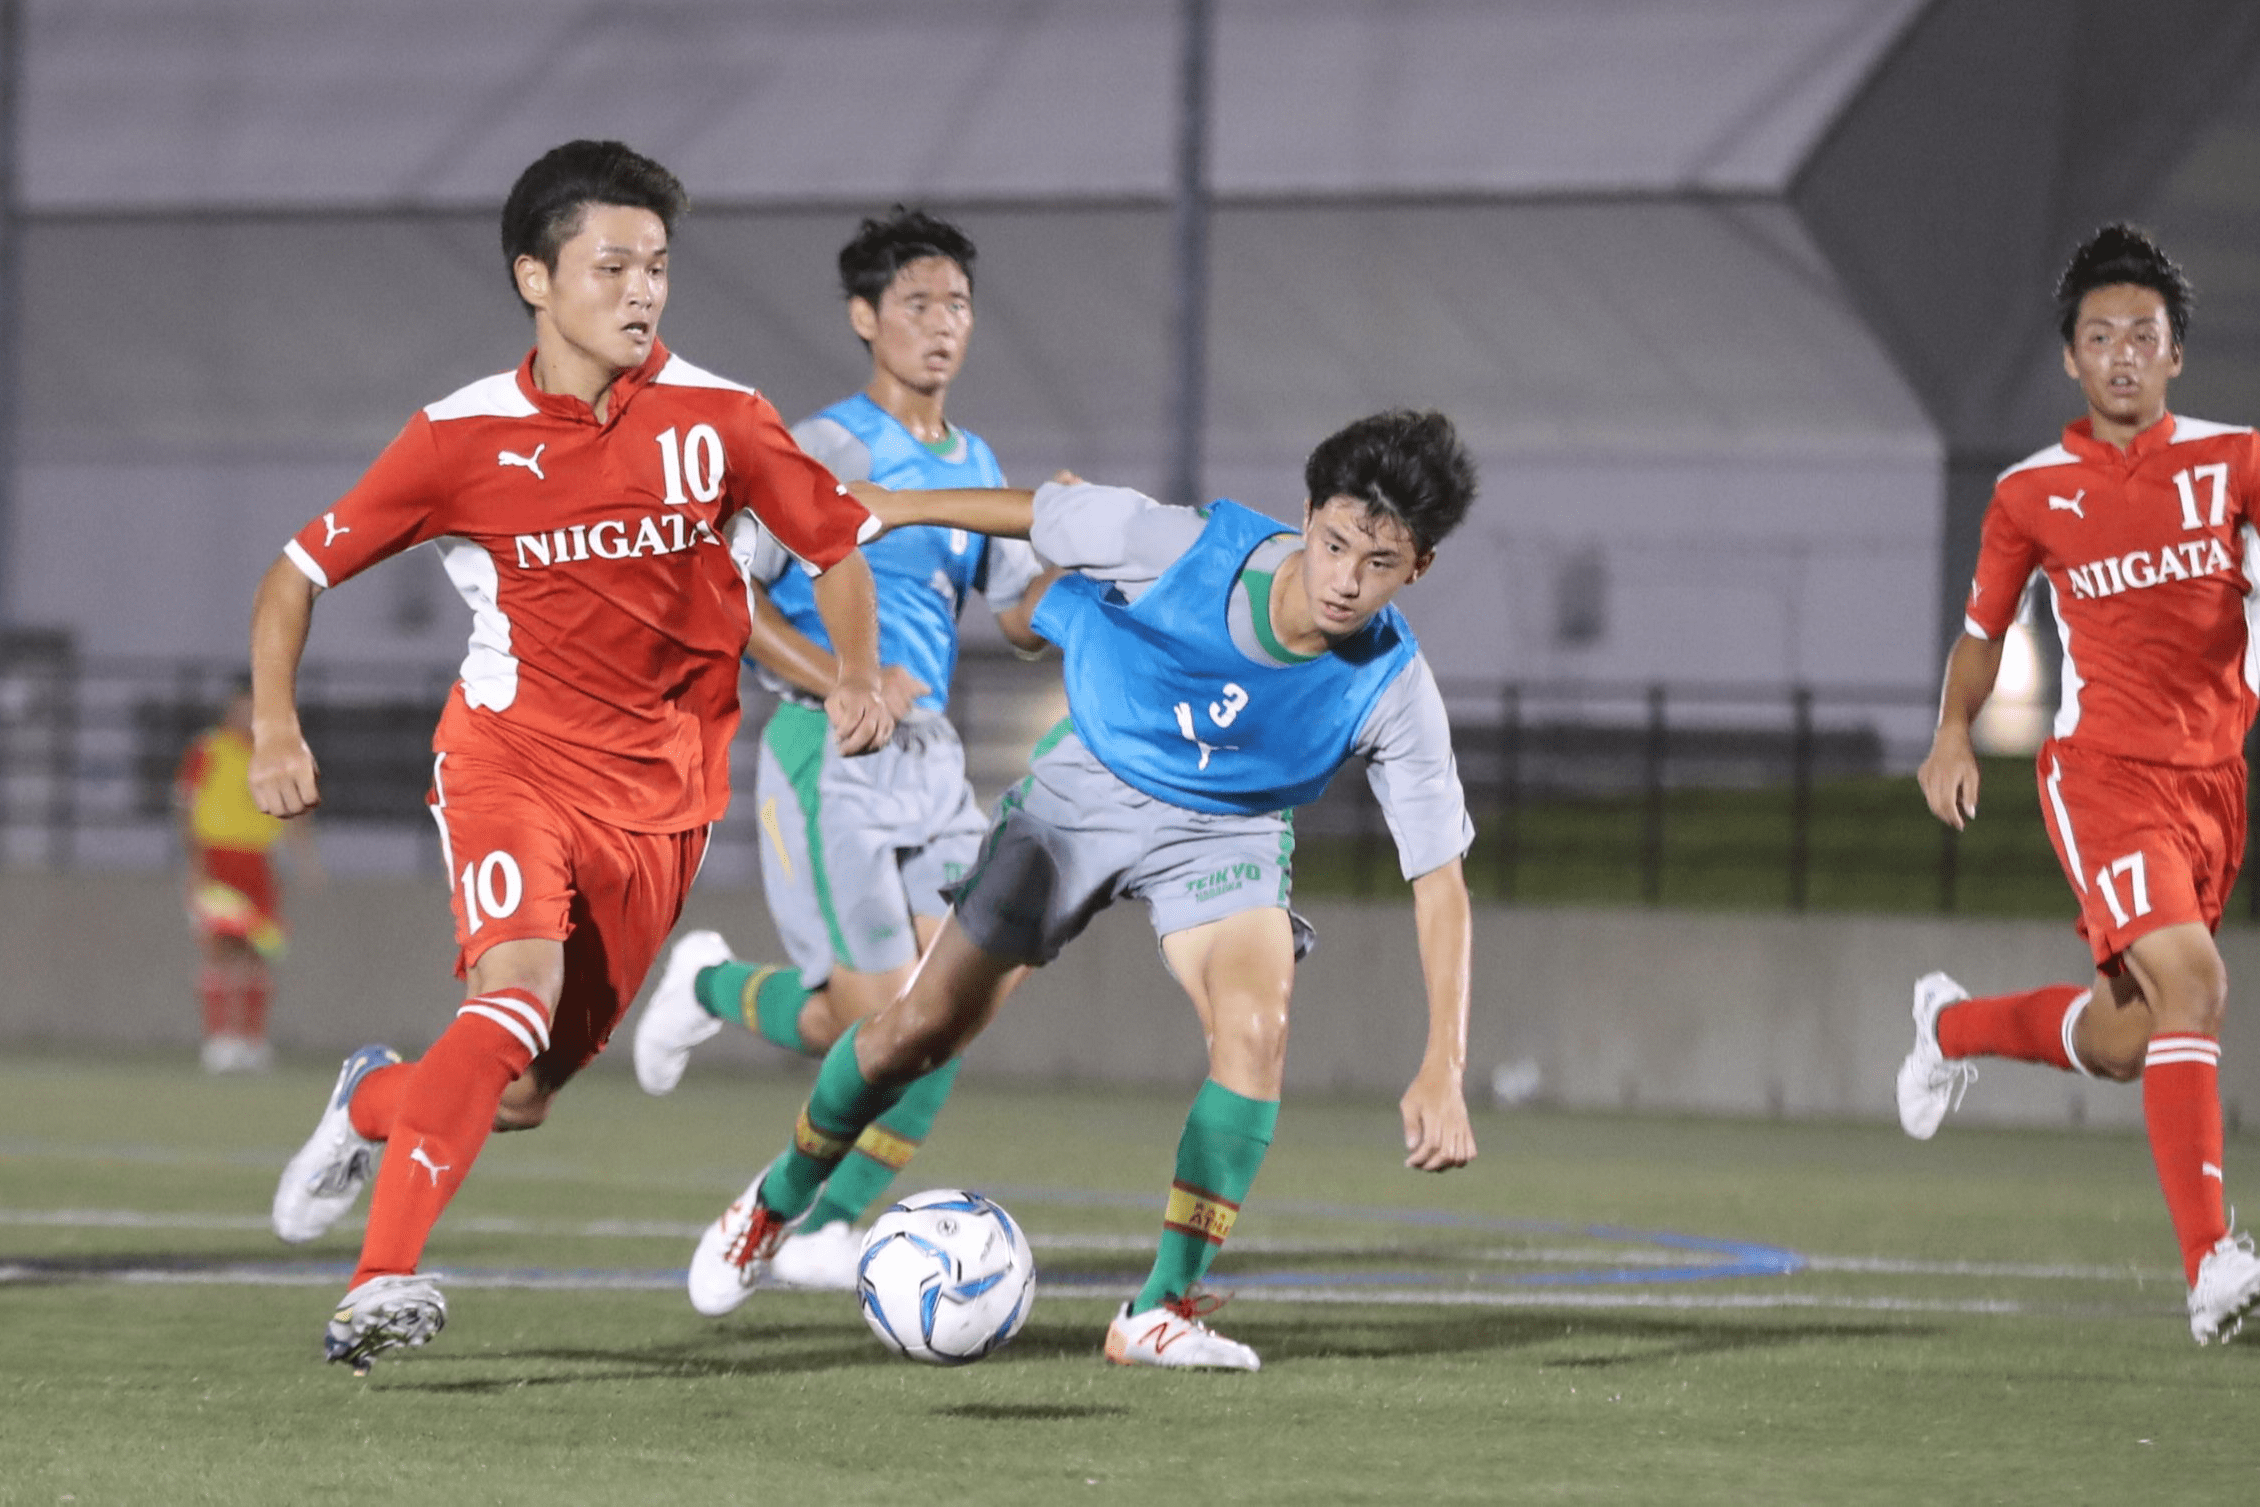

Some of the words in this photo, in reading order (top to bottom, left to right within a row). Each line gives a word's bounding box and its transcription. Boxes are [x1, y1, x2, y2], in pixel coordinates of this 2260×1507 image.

[655, 423, 725, 505] 10
[2171, 462, 2229, 531] 17
[2067, 536, 2233, 600] NIIGATA
[1208, 682, 1249, 728] 3
[460, 849, 523, 936] 10
[1185, 862, 1262, 892] TEIKYO
[2095, 849, 2152, 930] 17
